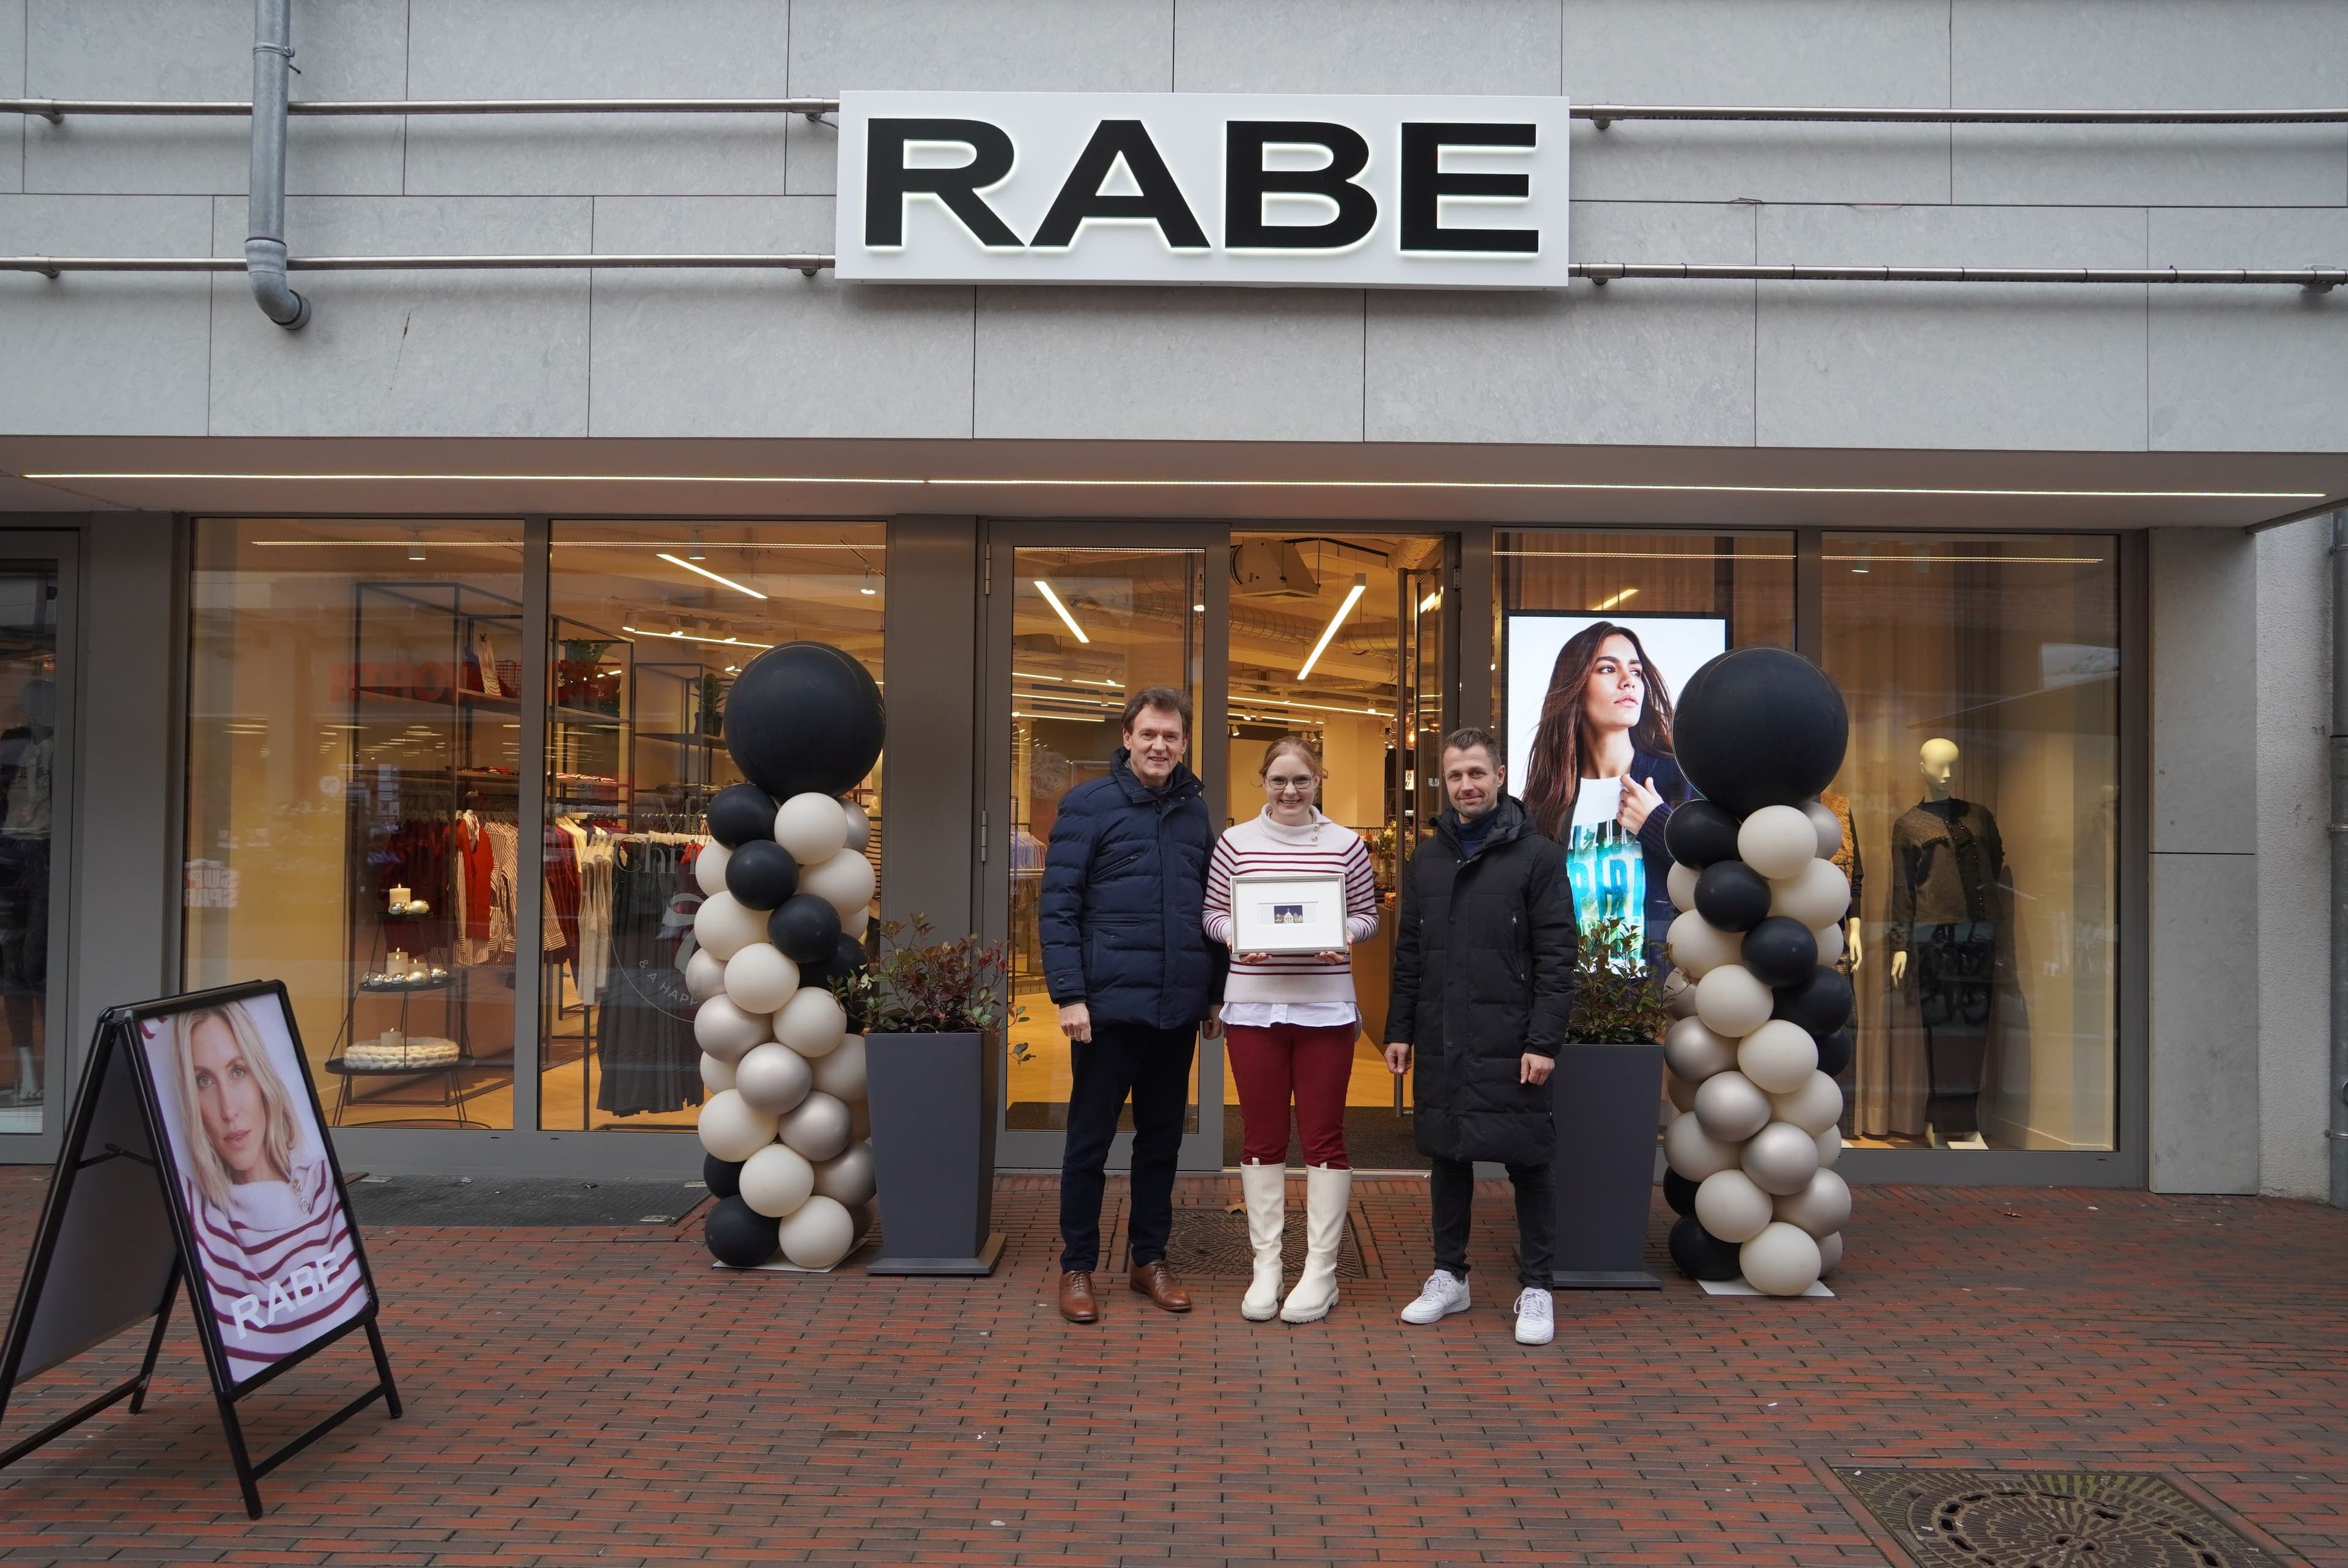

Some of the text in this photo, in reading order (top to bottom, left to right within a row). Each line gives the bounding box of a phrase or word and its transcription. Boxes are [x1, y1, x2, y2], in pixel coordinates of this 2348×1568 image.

[865, 117, 1539, 253] RABE
[639, 959, 649, 969] &
[647, 973, 657, 983] A
[231, 1251, 345, 1340] RABE
